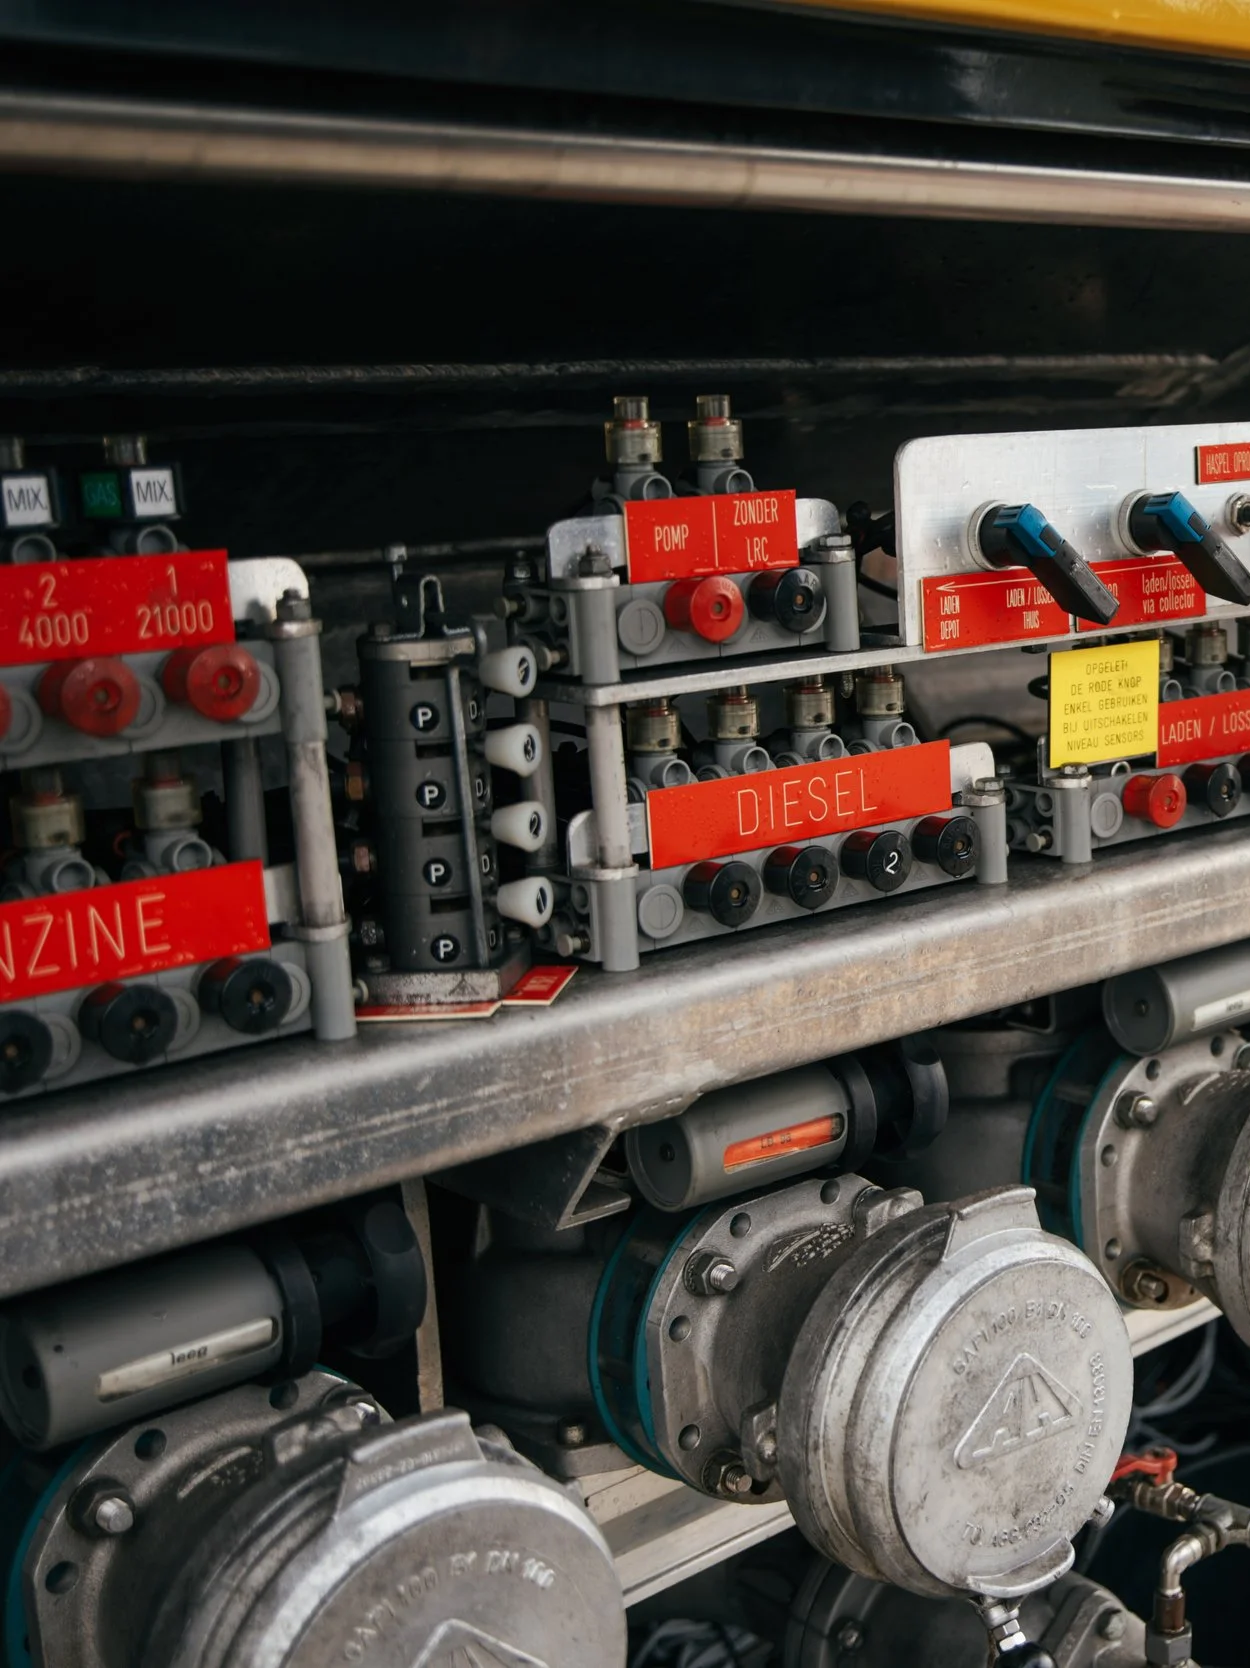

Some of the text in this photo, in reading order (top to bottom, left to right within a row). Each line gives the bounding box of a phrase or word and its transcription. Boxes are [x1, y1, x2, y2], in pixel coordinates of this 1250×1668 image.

[1206, 453, 1230, 475] HASPEL
[733, 498, 778, 526] ZONDER
[654, 524, 689, 552] POMP
[746, 536, 769, 563] LRC
[39, 564, 178, 609] 2 1
[940, 595, 960, 616] LADEN
[1006, 588, 1026, 608] LADEN
[1142, 593, 1195, 615] via collector
[18, 599, 214, 648] 4000 21000
[940, 619, 960, 640] DEPOT
[1023, 611, 1040, 630] THUIS
[1070, 676, 1142, 696] DE RODE KNOP
[1064, 694, 1148, 716] ENKEL GEBRUIKEN
[417, 707, 432, 728] P
[1063, 711, 1149, 734] BIJ UITSCHAKELEN
[1067, 730, 1145, 752] NIVEAU SENSORS
[1161, 718, 1201, 745] LADEN
[424, 785, 439, 805] P
[737, 768, 878, 836] DIESEL
[430, 863, 445, 883] P
[885, 851, 898, 874] 2
[439, 939, 453, 959] P
[1074, 1443, 1096, 1475] DIN
